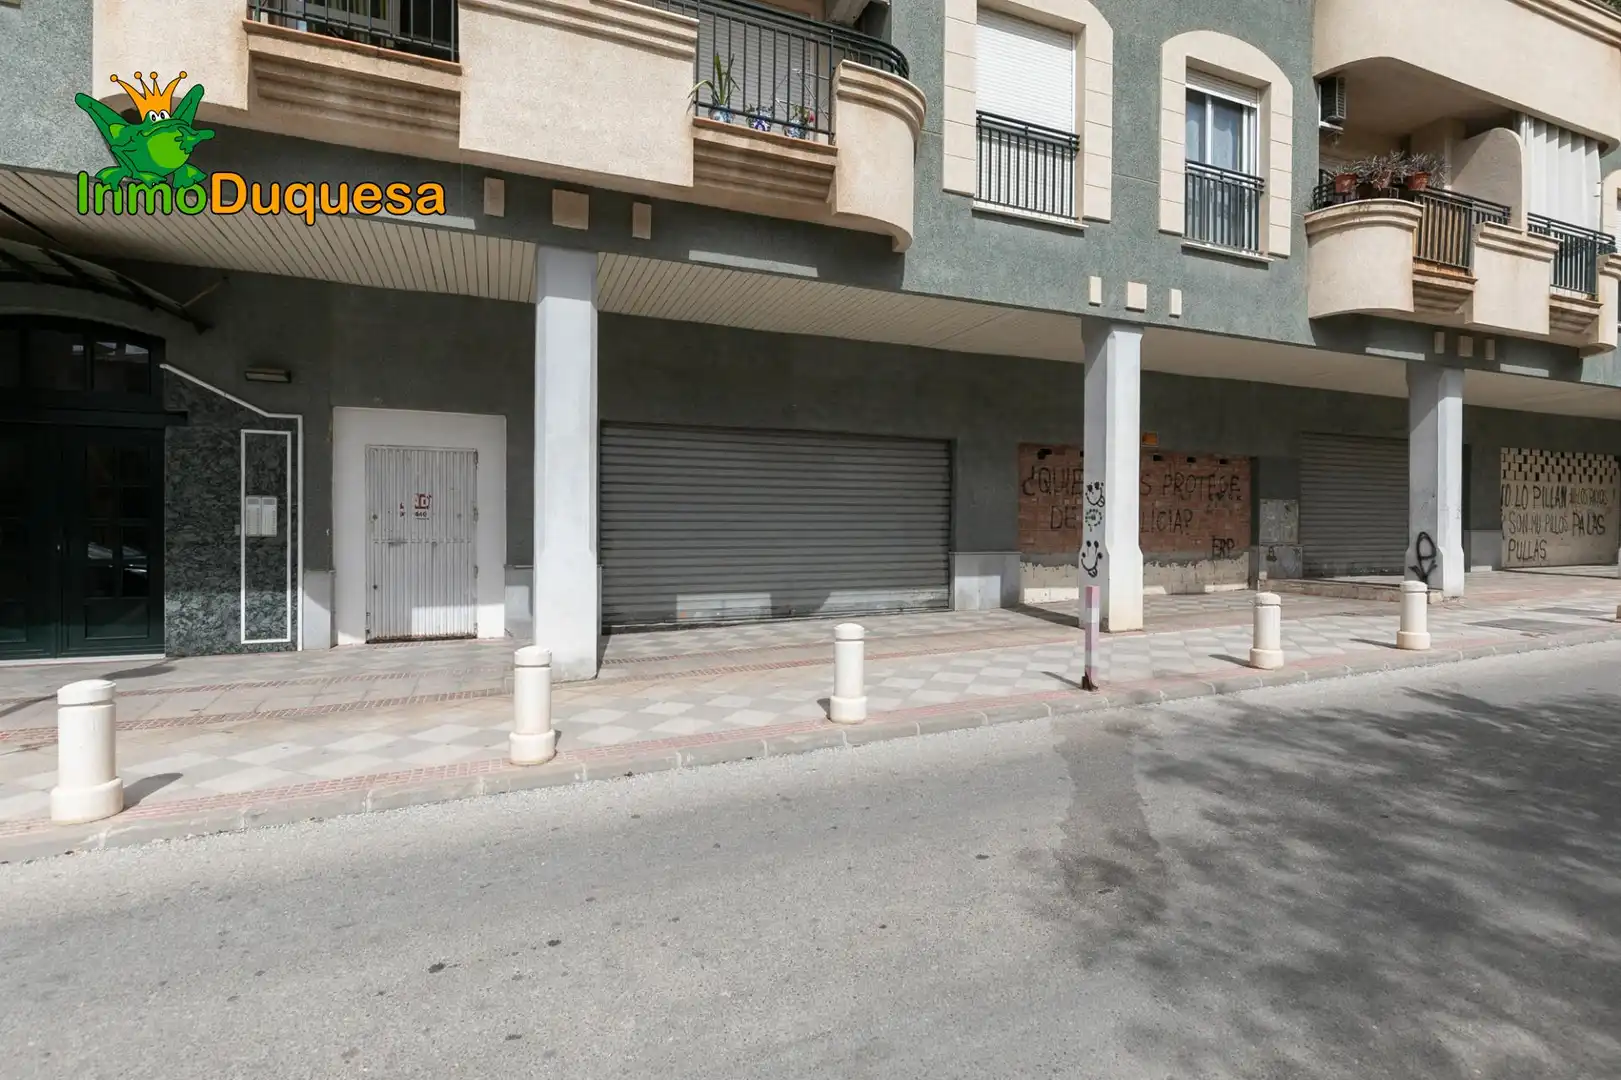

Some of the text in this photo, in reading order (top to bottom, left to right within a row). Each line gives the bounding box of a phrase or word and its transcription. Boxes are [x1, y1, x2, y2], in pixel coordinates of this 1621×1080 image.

[1022, 466, 1083, 497] ¿QUIE
[1532, 485, 1568, 509] PILLAN
[1140, 508, 1194, 535] LICIA?
[1507, 538, 1548, 562] PULLAS
